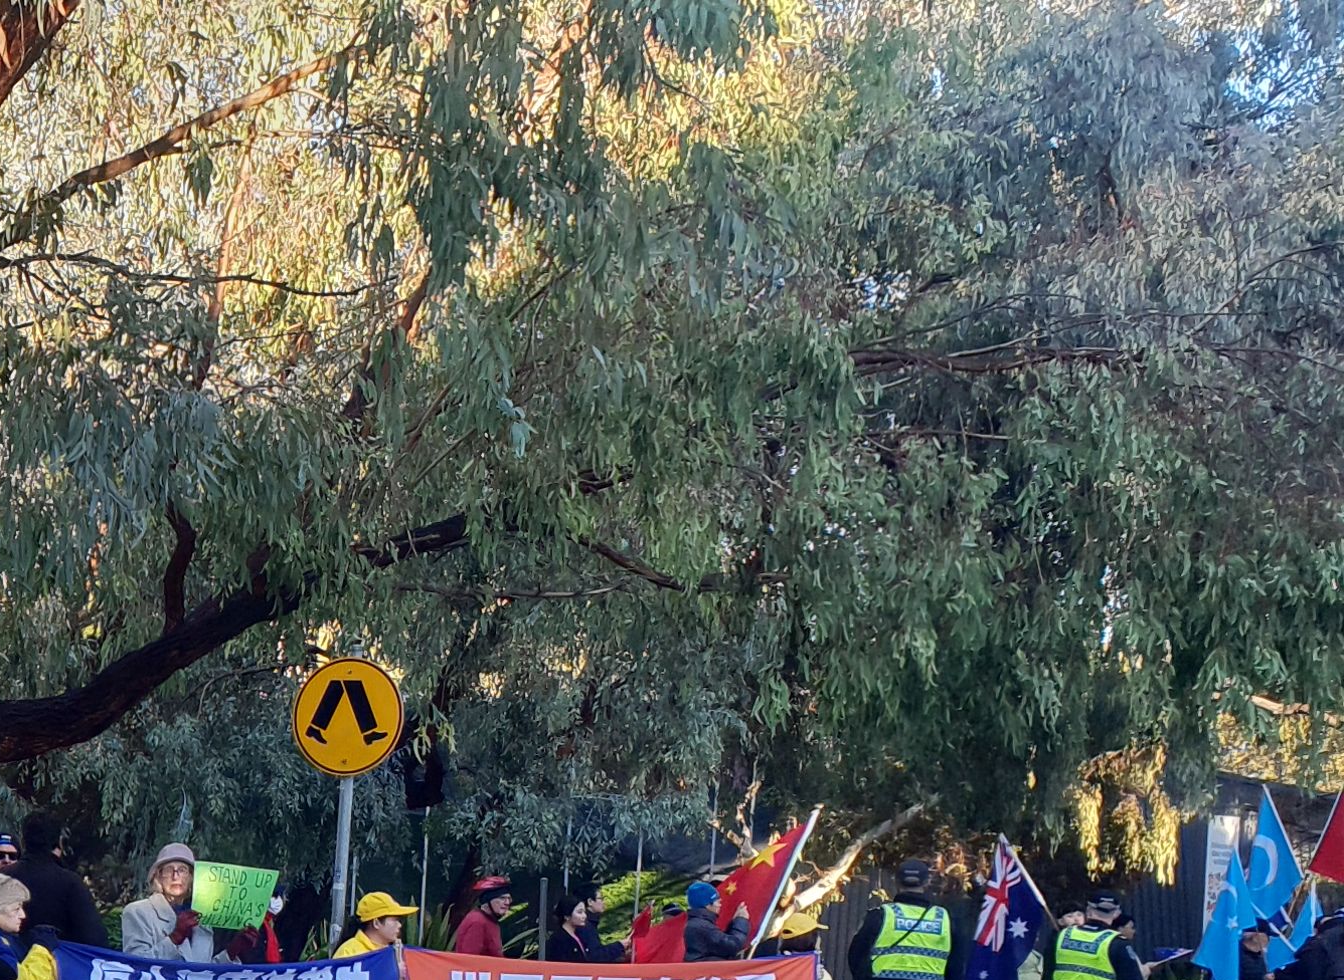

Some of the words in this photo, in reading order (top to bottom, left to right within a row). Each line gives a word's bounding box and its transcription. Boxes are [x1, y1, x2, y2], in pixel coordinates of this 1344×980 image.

[208, 866, 247, 886] STAND
[255, 872, 272, 888] UP
[229, 886, 247, 900] TO
[213, 899, 264, 917] CHINA'S
[1062, 937, 1097, 953] POLICE
